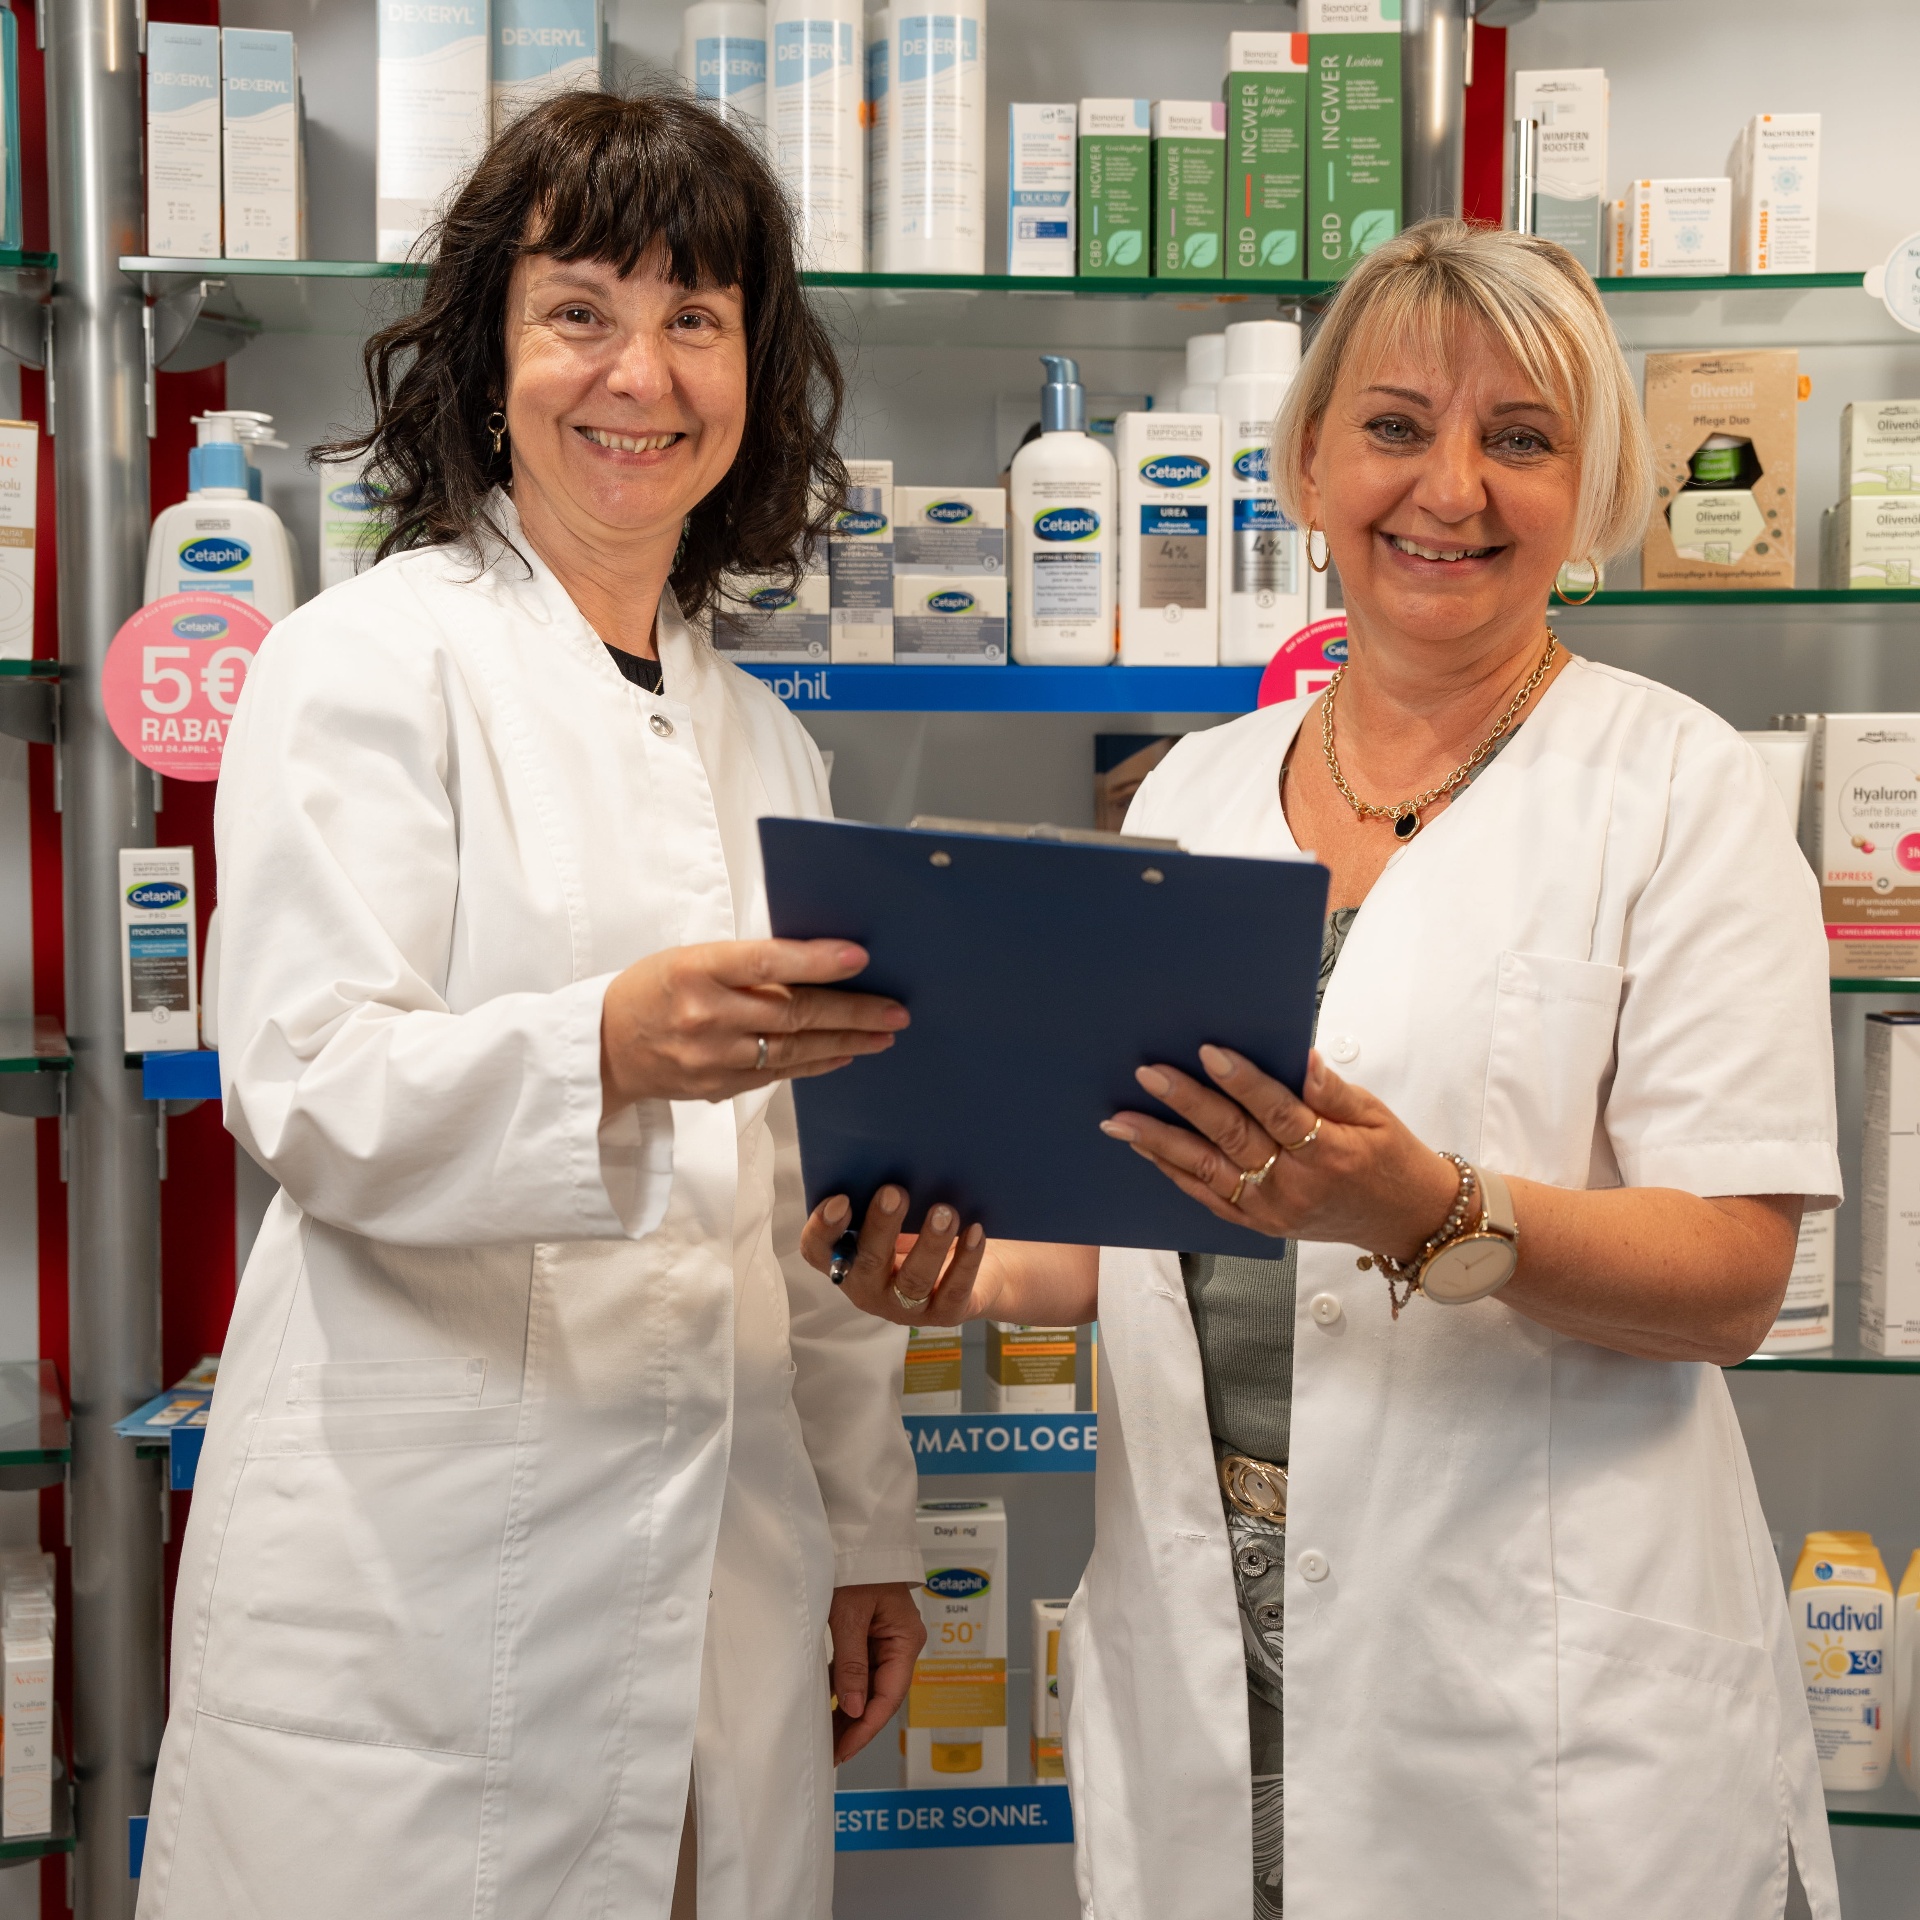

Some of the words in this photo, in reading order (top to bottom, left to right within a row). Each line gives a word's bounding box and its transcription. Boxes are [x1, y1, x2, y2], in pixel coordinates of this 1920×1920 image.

[387, 4, 475, 25] DEXERYL
[501, 28, 586, 47] DEXERYL
[1345, 54, 1383, 68] Lotion
[153, 71, 213, 88] DEXERYL
[229, 77, 289, 94] DEXERYL
[1321, 54, 1340, 149] INGWER
[1242, 84, 1258, 163] INGWER
[1542, 131, 1590, 142] WIMPERN
[1542, 142, 1586, 152] BOOSTER
[1090, 144, 1102, 198] INGWER
[1168, 146, 1180, 200] INGWER
[1322, 213, 1341, 260] CBD
[1090, 239, 1102, 268] CBD
[1239, 227, 1256, 266] CBD
[1167, 241, 1179, 270] CBD
[1690, 381, 1754, 398] Olivenöl
[1693, 415, 1727, 428] Pflege
[1729, 415, 1751, 426] Duo
[1145, 465, 1203, 481] Cetaphil
[929, 507, 969, 519] Cetaphil
[1160, 508, 1188, 517] UREA
[1696, 510, 1740, 523] Olivenöl
[841, 518, 883, 532] Cetaphil
[1039, 517, 1095, 534] Cetaphil
[1160, 541, 1189, 560] 4%
[1252, 536, 1282, 556] 4%
[184, 547, 243, 564] Cetaphil
[931, 596, 970, 608] Cetaphil
[178, 621, 220, 633] Cetaphil
[140, 645, 192, 715] 5
[200, 645, 255, 716] €
[142, 744, 163, 753] VOM
[1853, 786, 1917, 804] Hyaluron
[1852, 806, 1882, 818] Sanfte
[1884, 805, 1918, 817] Bräune
[1868, 821, 1900, 830] KÖRPER
[1828, 871, 1873, 881] EXPRESS
[132, 890, 182, 903] Cetaphil
[1842, 897, 1855, 906] Mit
[1866, 907, 1899, 918] Hyaluron
[131, 928, 186, 936] ITCHCONTROL
[928, 1577, 983, 1592] Cetaphil
[945, 1604, 968, 1613] SUN
[1807, 1602, 1883, 1631] Ladival
[1854, 1650, 1880, 1669] 30
[1807, 1686, 1870, 1696] ALLERGISCHE
[834, 1808, 890, 1832] ESTE
[897, 1807, 944, 1831] DER
[952, 1803, 1049, 1830] SONNE.
